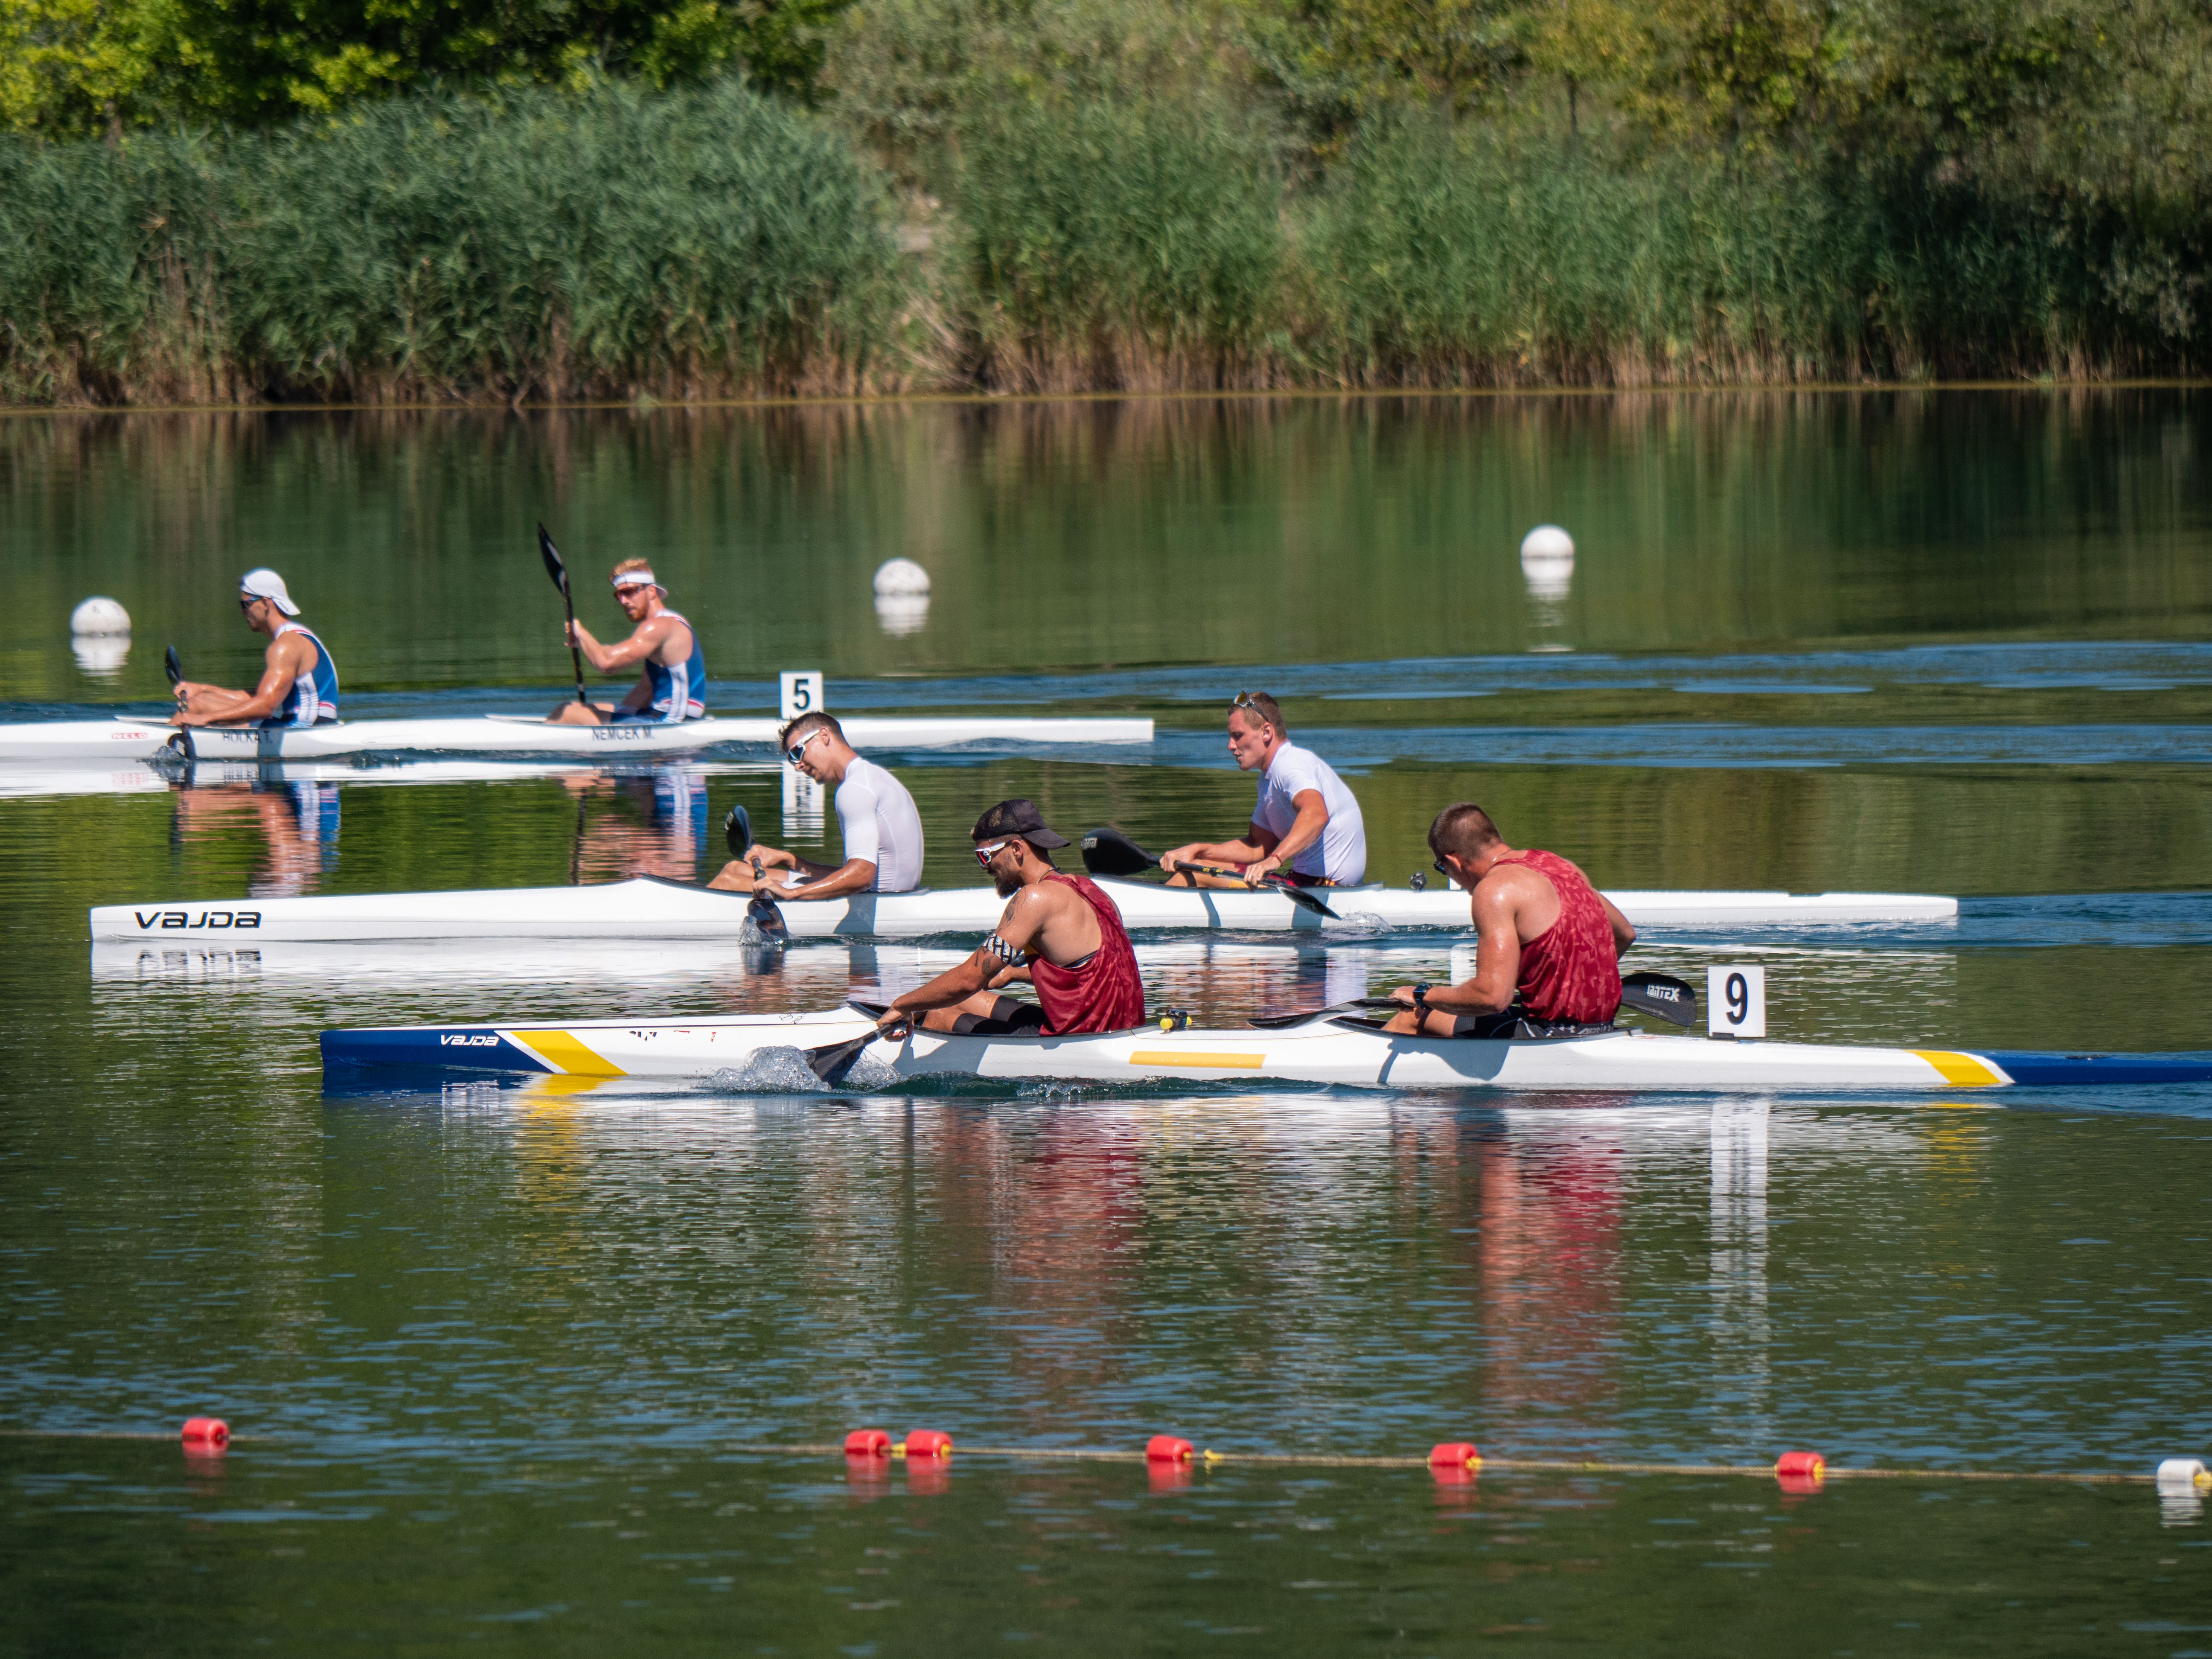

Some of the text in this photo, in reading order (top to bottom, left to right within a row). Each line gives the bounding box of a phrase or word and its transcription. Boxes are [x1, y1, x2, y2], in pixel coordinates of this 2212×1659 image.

[793, 678, 810, 711] 5
[223, 730, 272, 744] HOLKA T.
[1725, 972, 1748, 1025] 9
